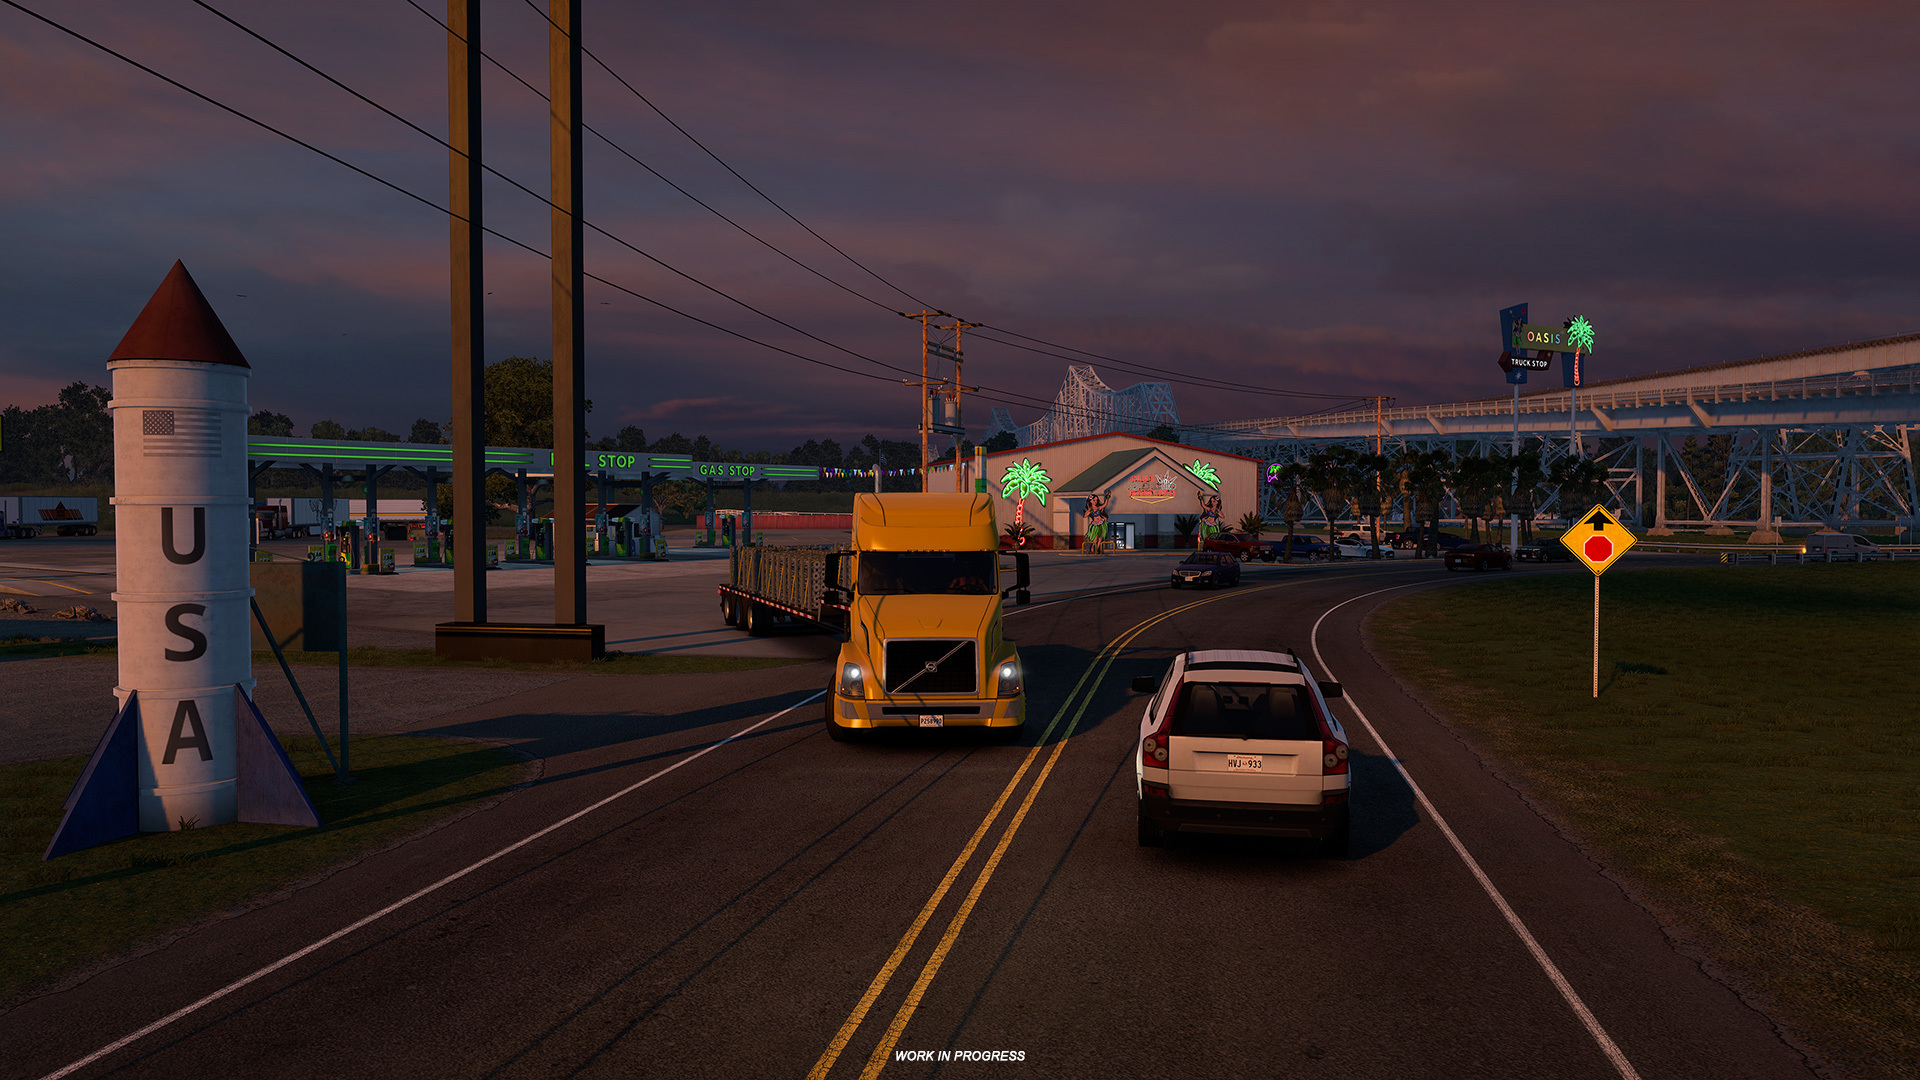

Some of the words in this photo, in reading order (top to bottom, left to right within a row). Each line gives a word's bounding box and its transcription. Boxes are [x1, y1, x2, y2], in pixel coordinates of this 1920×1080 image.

[1527, 331, 1560, 344] OASIS
[1511, 358, 1531, 367] TRUCK
[1532, 359, 1547, 368] STOP
[598, 454, 635, 468] STOP
[700, 464, 724, 476] GAS
[729, 465, 755, 477] STOP
[1248, 760, 1262, 769] 933
